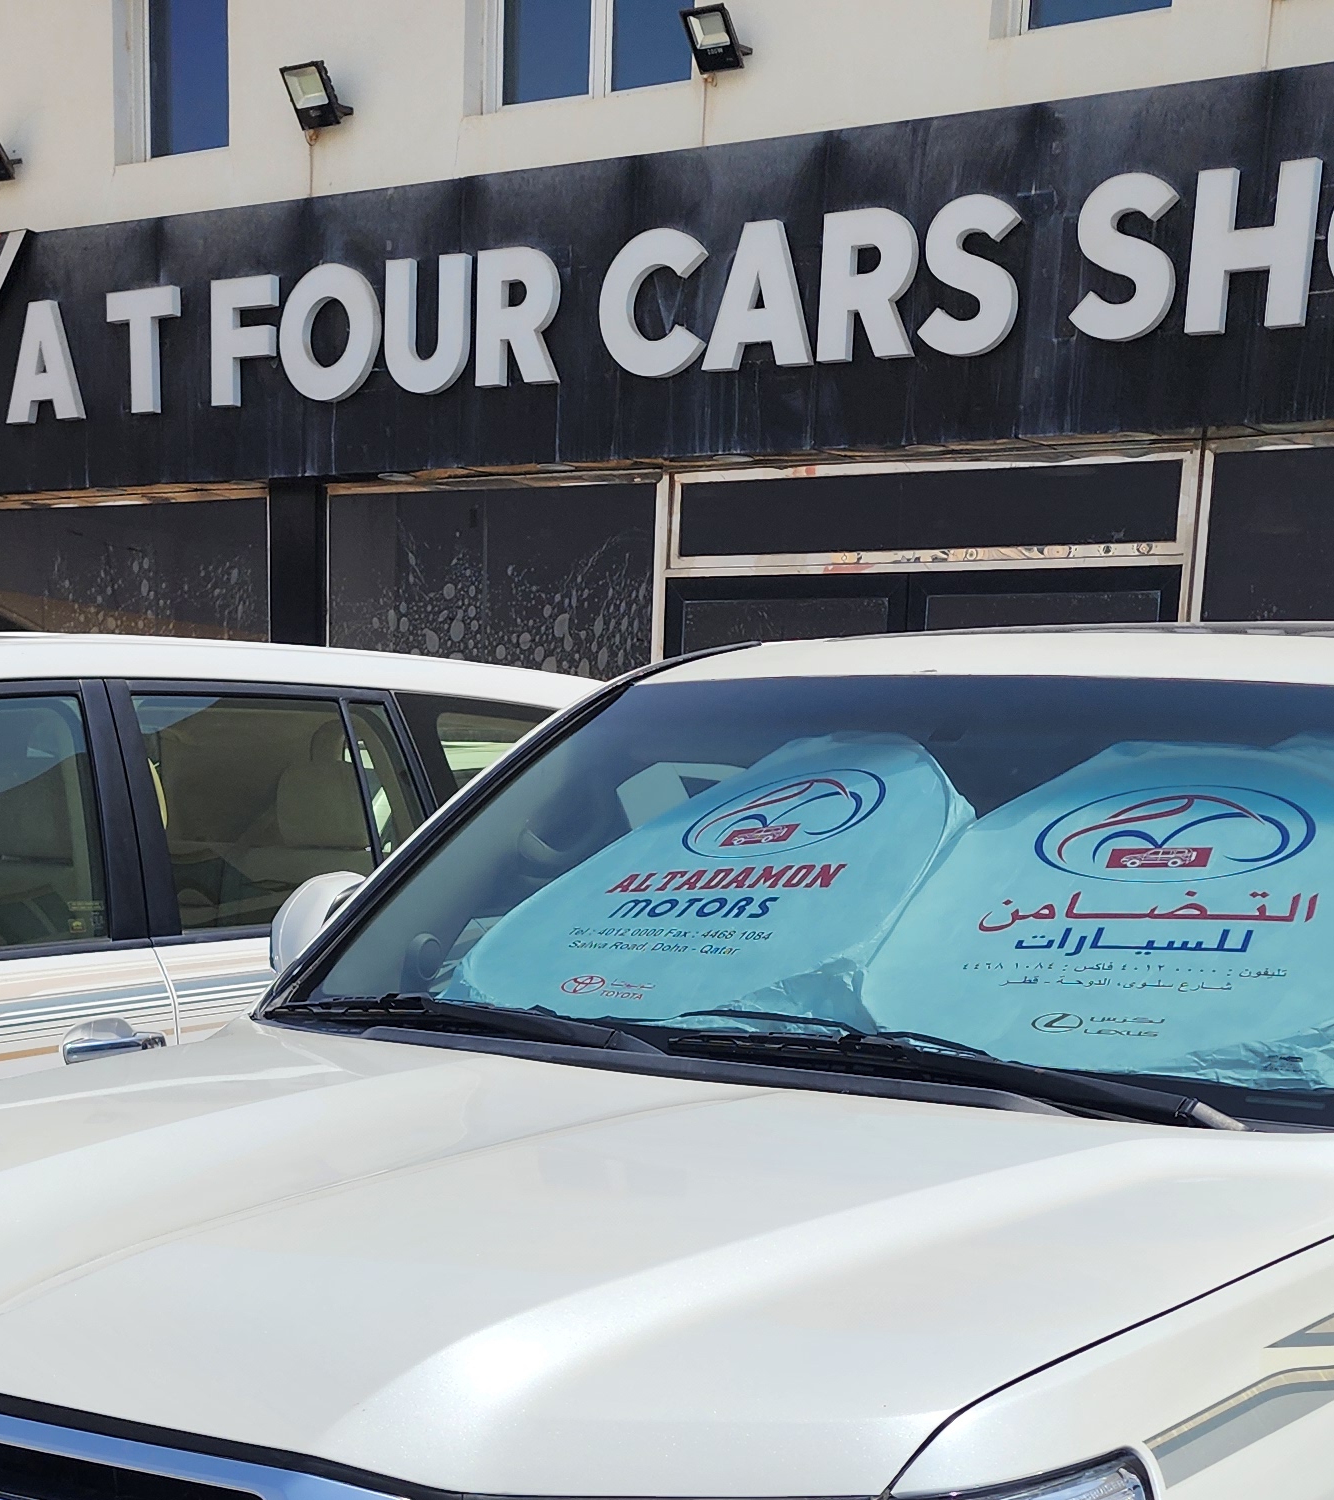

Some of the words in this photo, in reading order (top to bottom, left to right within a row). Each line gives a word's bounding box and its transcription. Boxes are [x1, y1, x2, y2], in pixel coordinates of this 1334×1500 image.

[211, 245, 562, 407] FOUR
[598, 194, 1022, 379] CARS
[605, 863, 848, 895] ALTADAMON
[607, 896, 780, 920] MOTORS
[977, 889, 1320, 933] التضامن
[700, 929, 736, 940] 4468
[739, 930, 773, 941] 1084
[1014, 926, 1254, 956] للسيارات
[650, 942, 689, 953] Doha
[699, 944, 741, 956] Qatar
[1073, 961, 1114, 973] فاكس
[999, 975, 1040, 987] قطر
[1056, 974, 1112, 988] الدوحة
[1177, 981, 1233, 993] شارع
[599, 989, 644, 1000] TOYOTA
[1083, 1028, 1160, 1038] LEXUS
